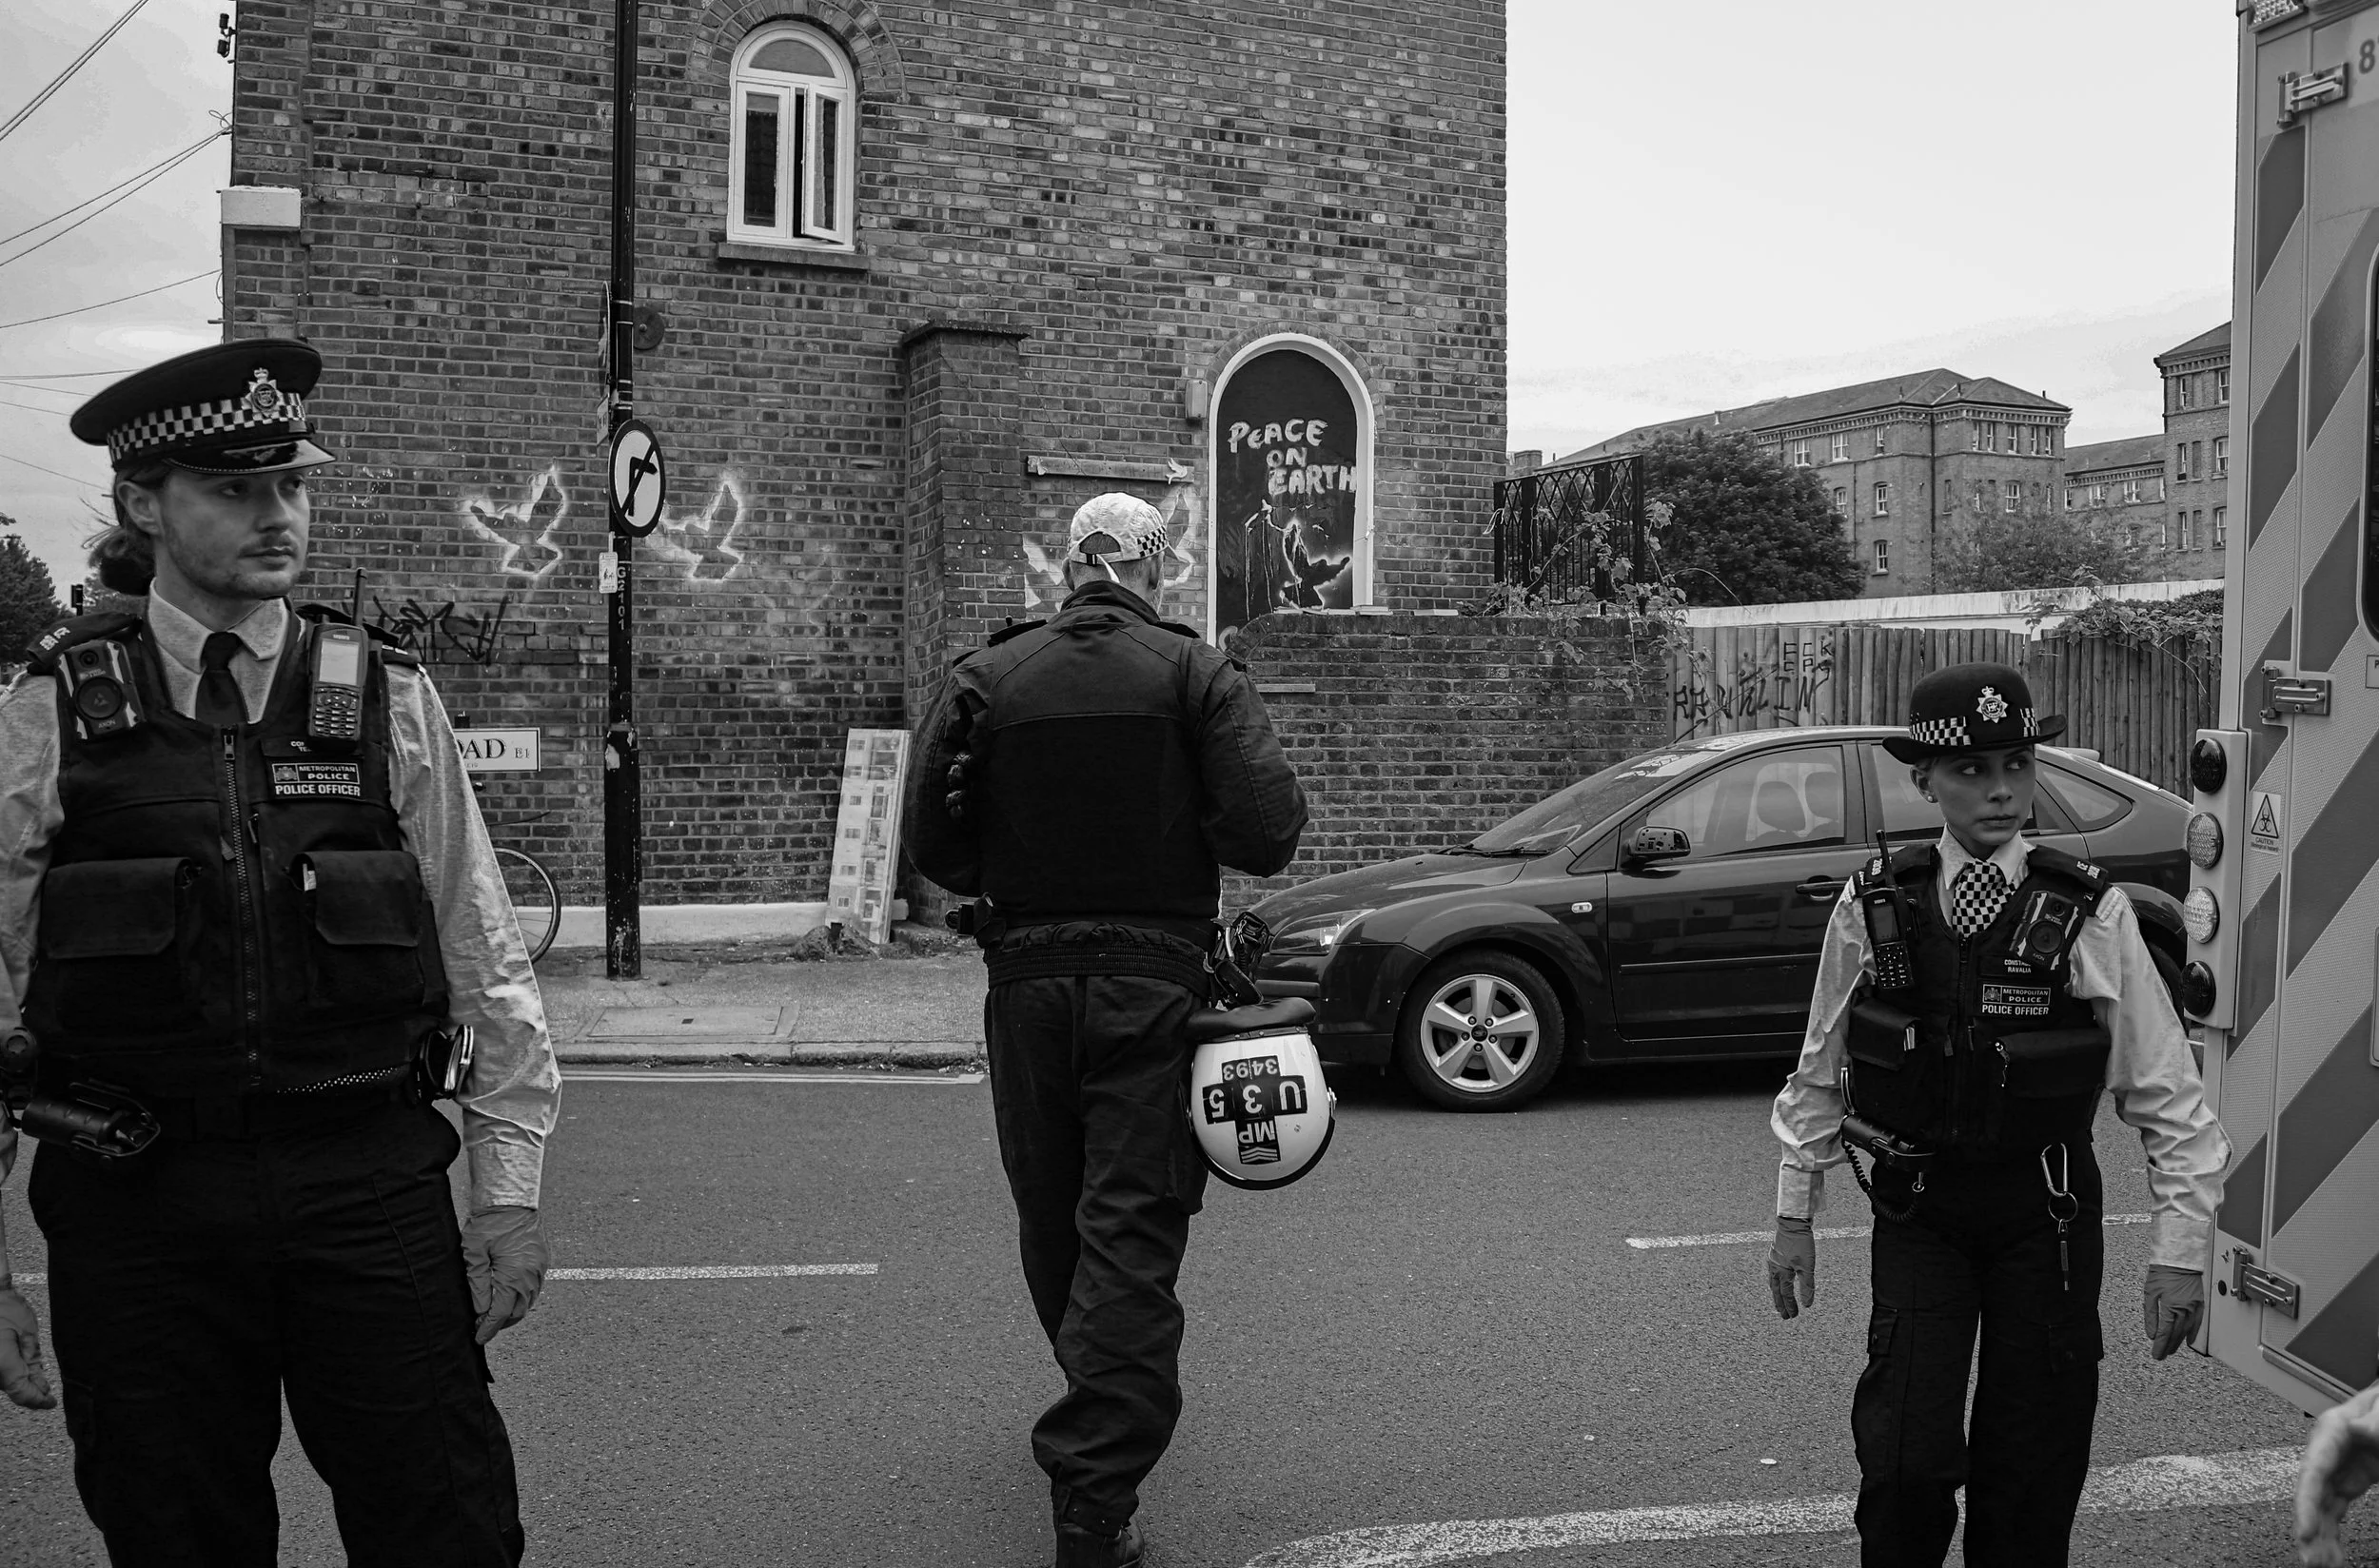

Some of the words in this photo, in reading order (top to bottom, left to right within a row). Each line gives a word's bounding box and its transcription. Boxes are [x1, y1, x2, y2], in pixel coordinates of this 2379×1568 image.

[2359, 35, 2379, 74] 8
[1266, 447, 1307, 468] ON
[1267, 464, 1357, 496] EARTH
[457, 737, 506, 759] AD
[515, 748, 530, 758] E1
[275, 785, 316, 795] POLICE
[318, 785, 361, 796] OFFICER
[1982, 1004, 2013, 1015] POLICE
[2015, 1006, 2049, 1015] OFFICER
[1223, 1058, 1278, 1081] 3493
[1238, 1120, 1276, 1144] MP
